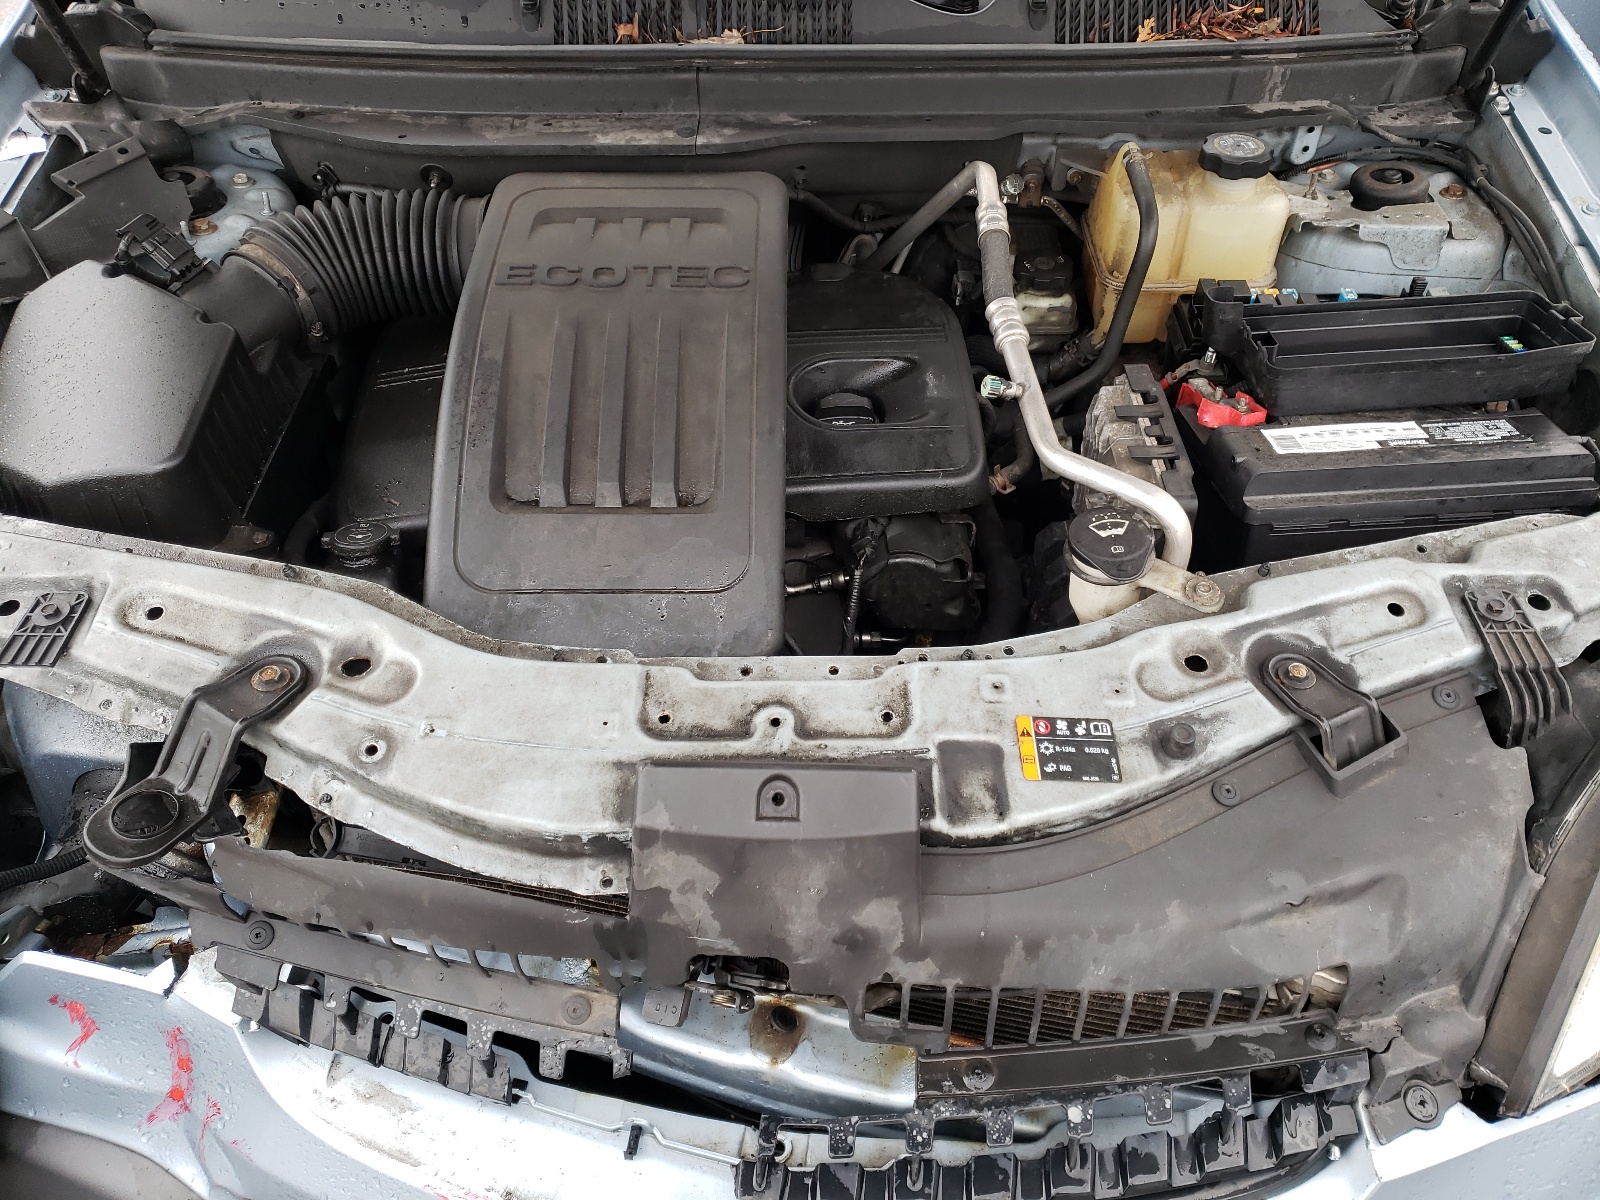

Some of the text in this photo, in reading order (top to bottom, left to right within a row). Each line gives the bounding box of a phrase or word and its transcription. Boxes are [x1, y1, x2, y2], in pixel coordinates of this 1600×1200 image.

[495, 262, 751, 289] ECOTEC
[1055, 745, 1076, 753] R-134a
[1059, 764, 1072, 772] PAG
